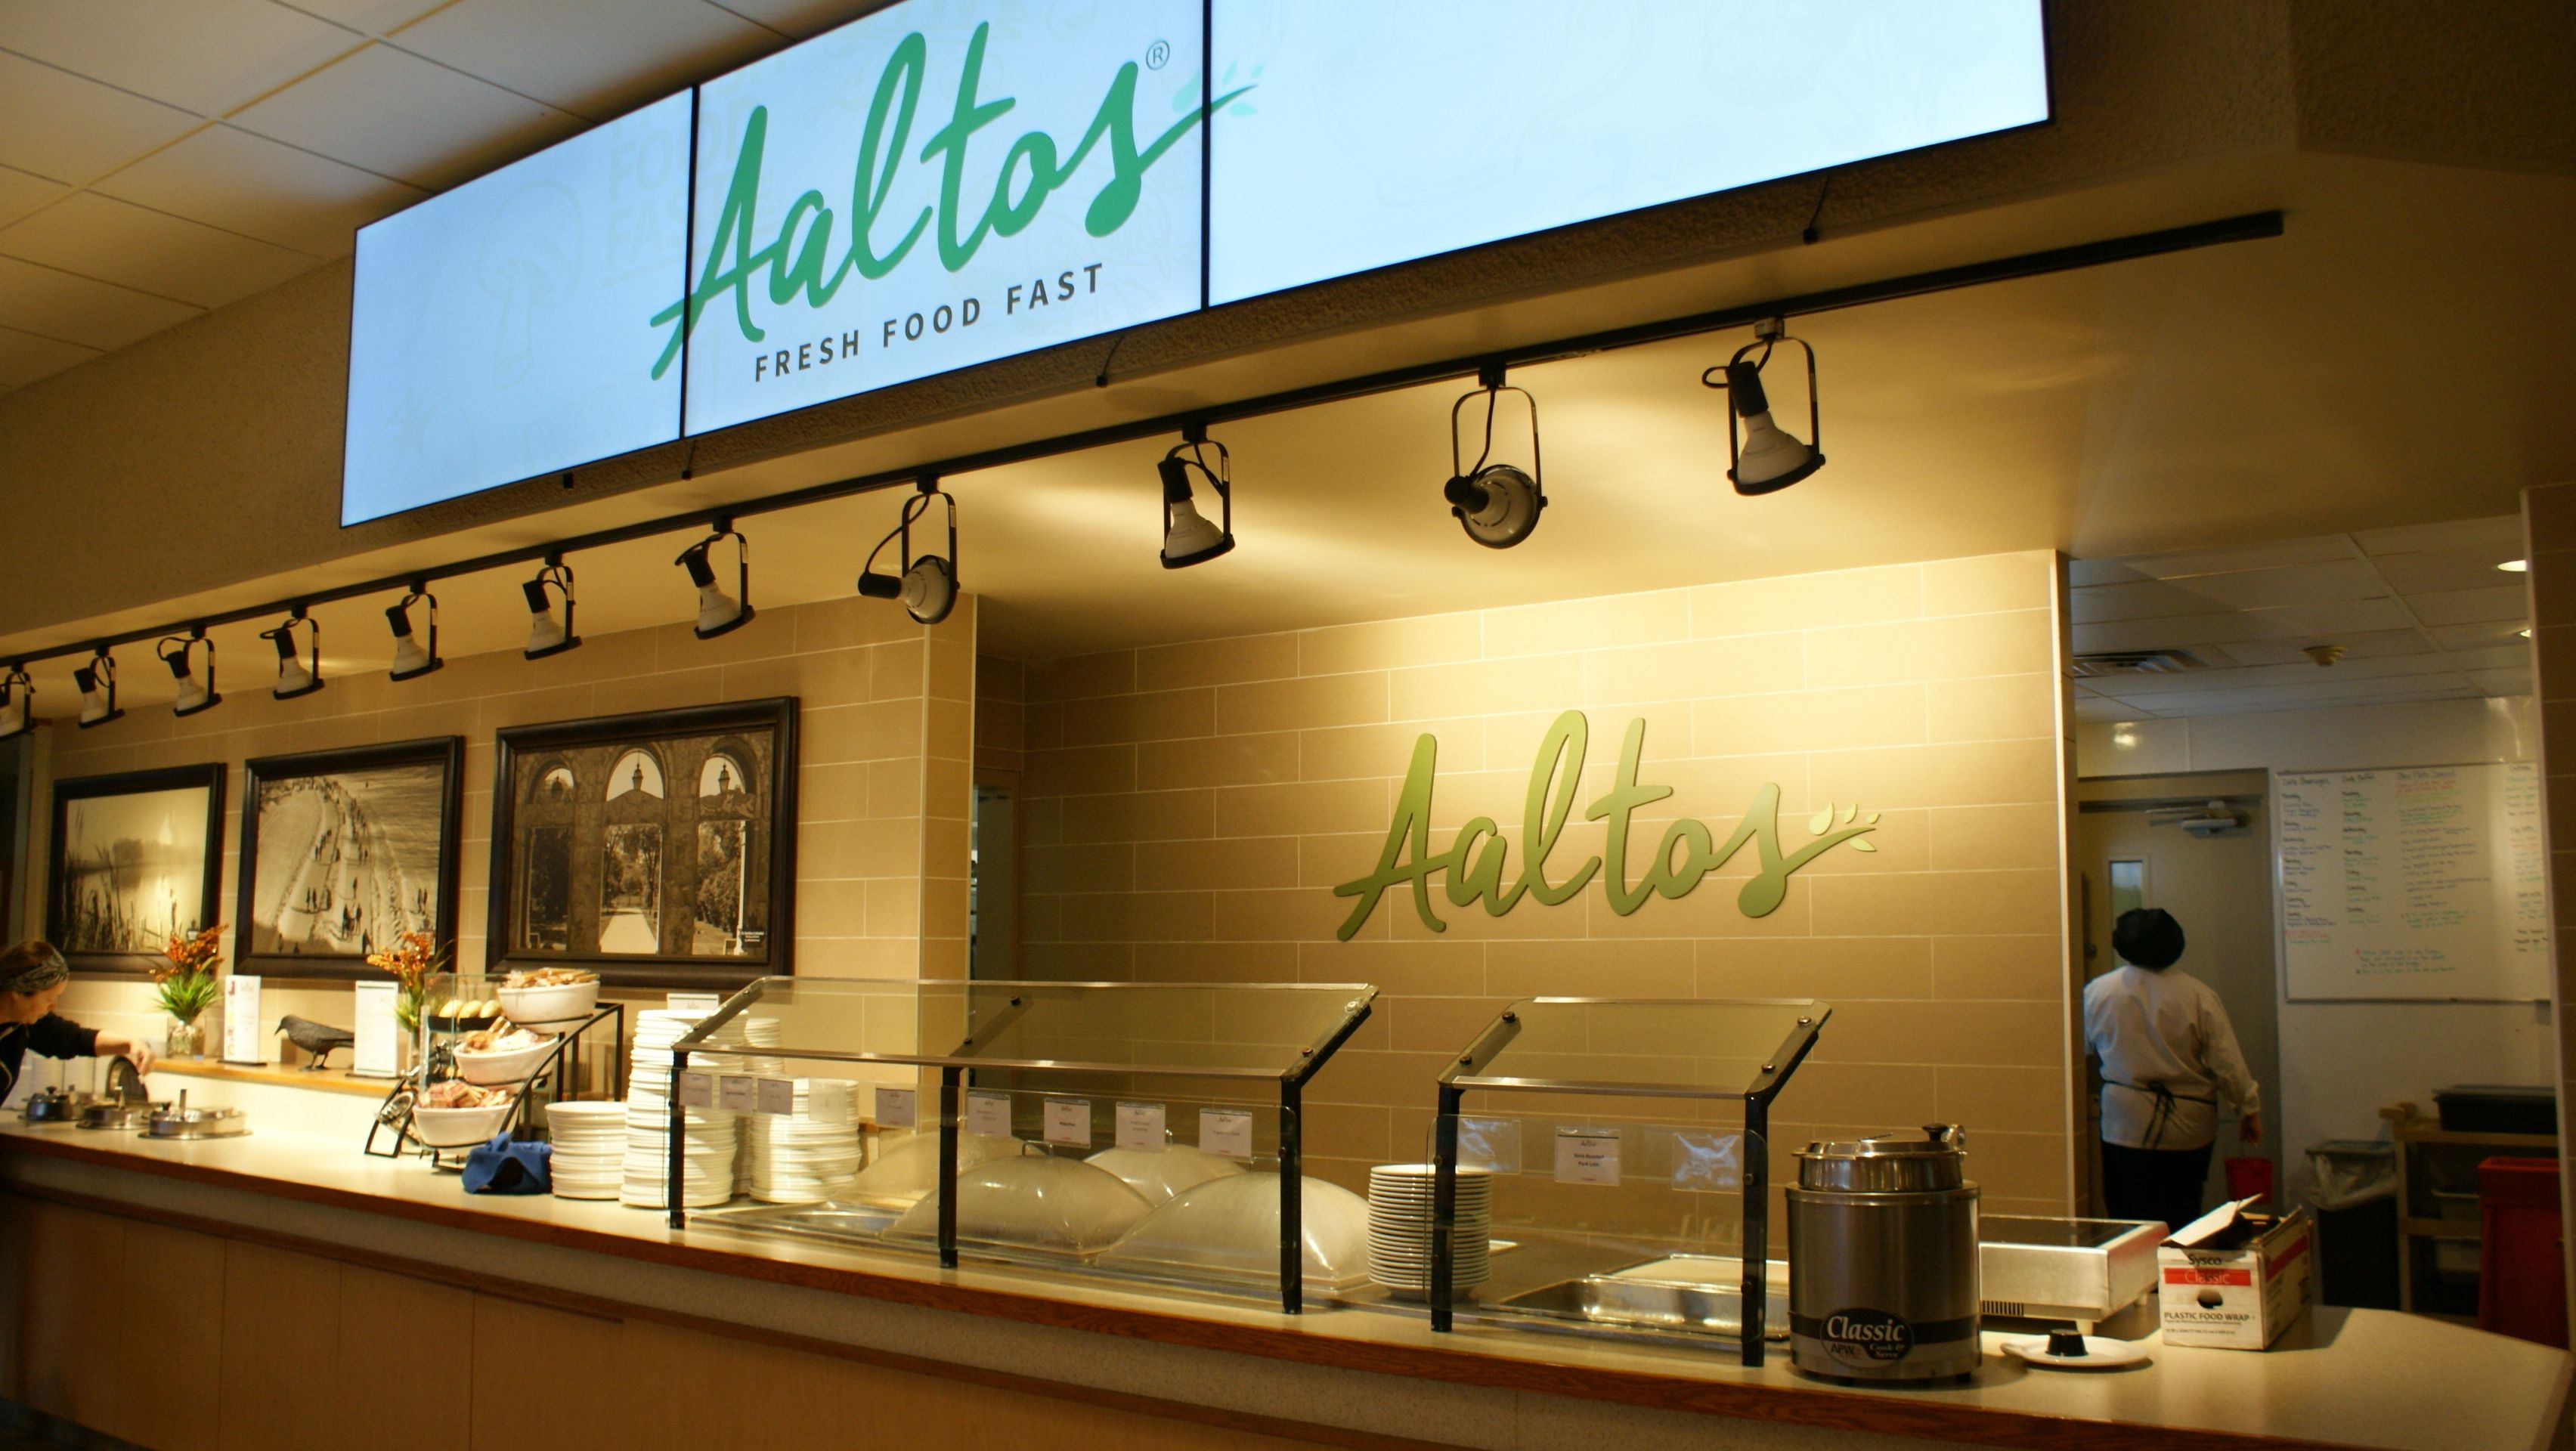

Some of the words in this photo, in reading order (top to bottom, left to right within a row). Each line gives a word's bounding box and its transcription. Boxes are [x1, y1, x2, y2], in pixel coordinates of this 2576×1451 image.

[651, 21, 1258, 380] Aaltos
[755, 329, 859, 382] FRESH
[883, 298, 980, 348] FOOD
[1007, 262, 1103, 315] FAST
[1333, 709, 1878, 942] Aaltos
[2184, 1270, 2231, 1285] Classic
[2188, 1254, 2222, 1267] Sysco
[1826, 1315, 1905, 1342] Classic
